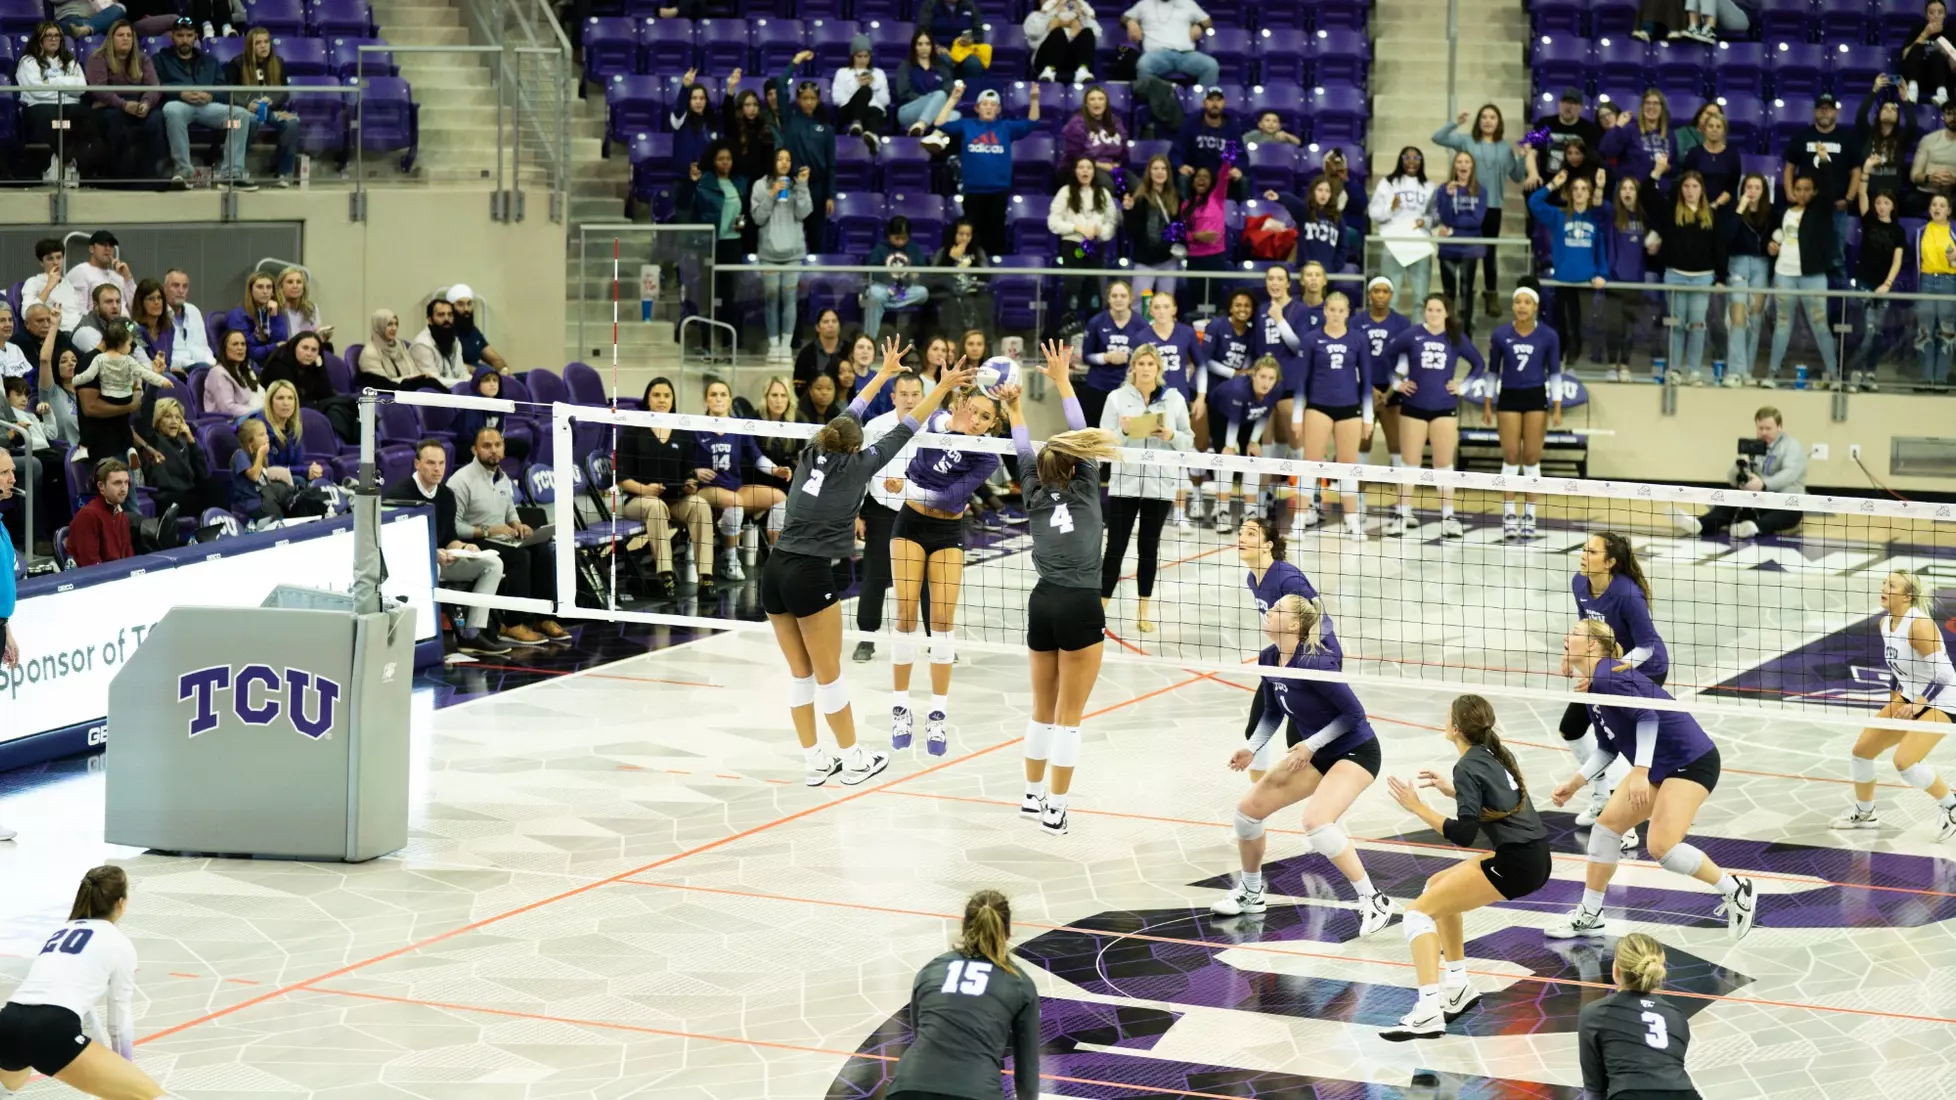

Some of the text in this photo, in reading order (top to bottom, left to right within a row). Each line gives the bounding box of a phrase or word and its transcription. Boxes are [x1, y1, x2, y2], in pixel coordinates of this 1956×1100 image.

[968, 143, 1005, 154] adidas
[1196, 135, 1226, 151] TCU
[1304, 222, 1340, 247] TCU
[1368, 329, 1388, 339] TCU
[1326, 344, 1347, 353] TCU
[1371, 339, 1383, 356] 3
[1423, 341, 1446, 352] TCU
[1512, 344, 1535, 354] TCU
[1222, 352, 1246, 369] 35
[1330, 353, 1344, 369] 2
[1421, 351, 1447, 370] 23
[1516, 355, 1529, 371] 7
[802, 468, 825, 497] 2
[1050, 503, 1075, 535] 4
[102, 627, 125, 665] of
[177, 663, 341, 741] TCU
[38, 928, 94, 956] 20
[941, 960, 993, 996] 15
[1641, 1011, 1669, 1049] 3
